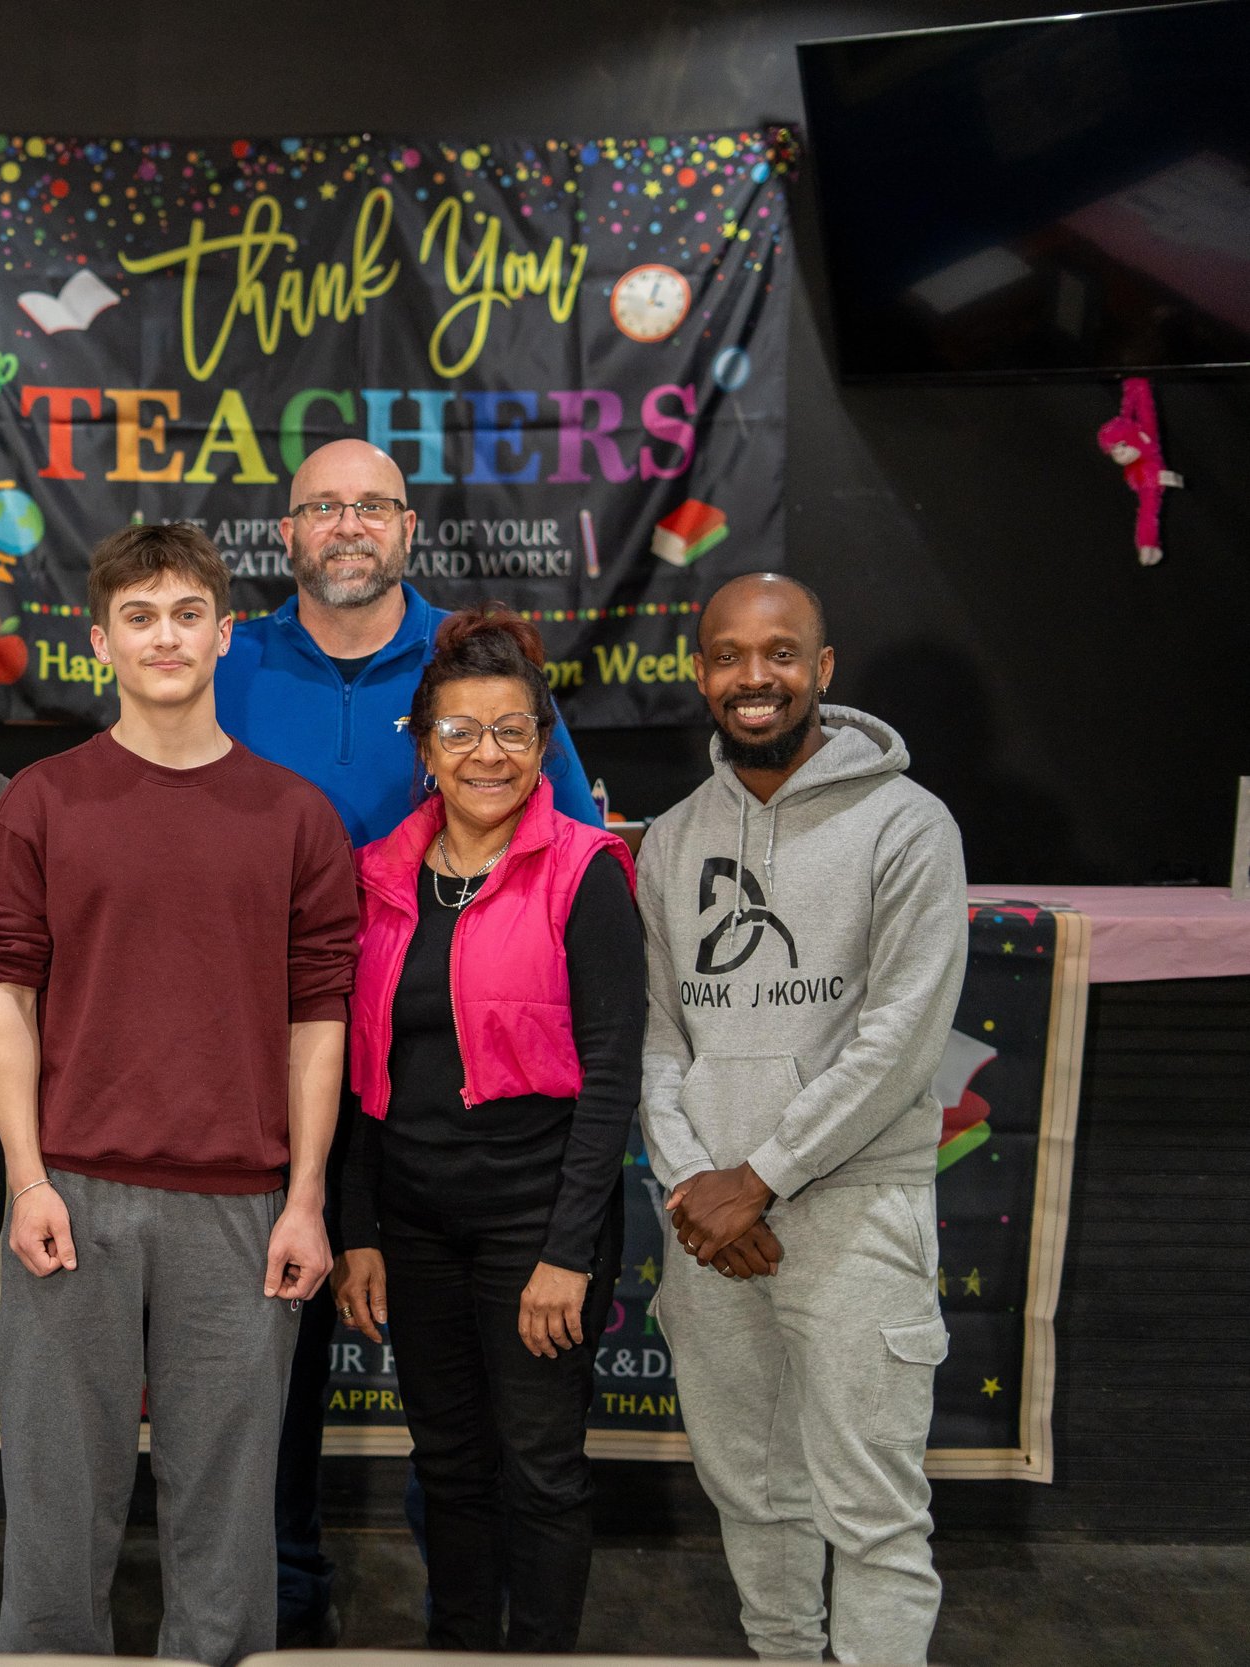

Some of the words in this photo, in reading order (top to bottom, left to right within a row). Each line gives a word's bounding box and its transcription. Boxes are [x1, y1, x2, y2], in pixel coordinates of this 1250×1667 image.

[20, 383, 697, 486] TEACHERS
[438, 518, 477, 547] OF
[481, 518, 561, 547] YOUR
[477, 549, 573, 578] WORK!
